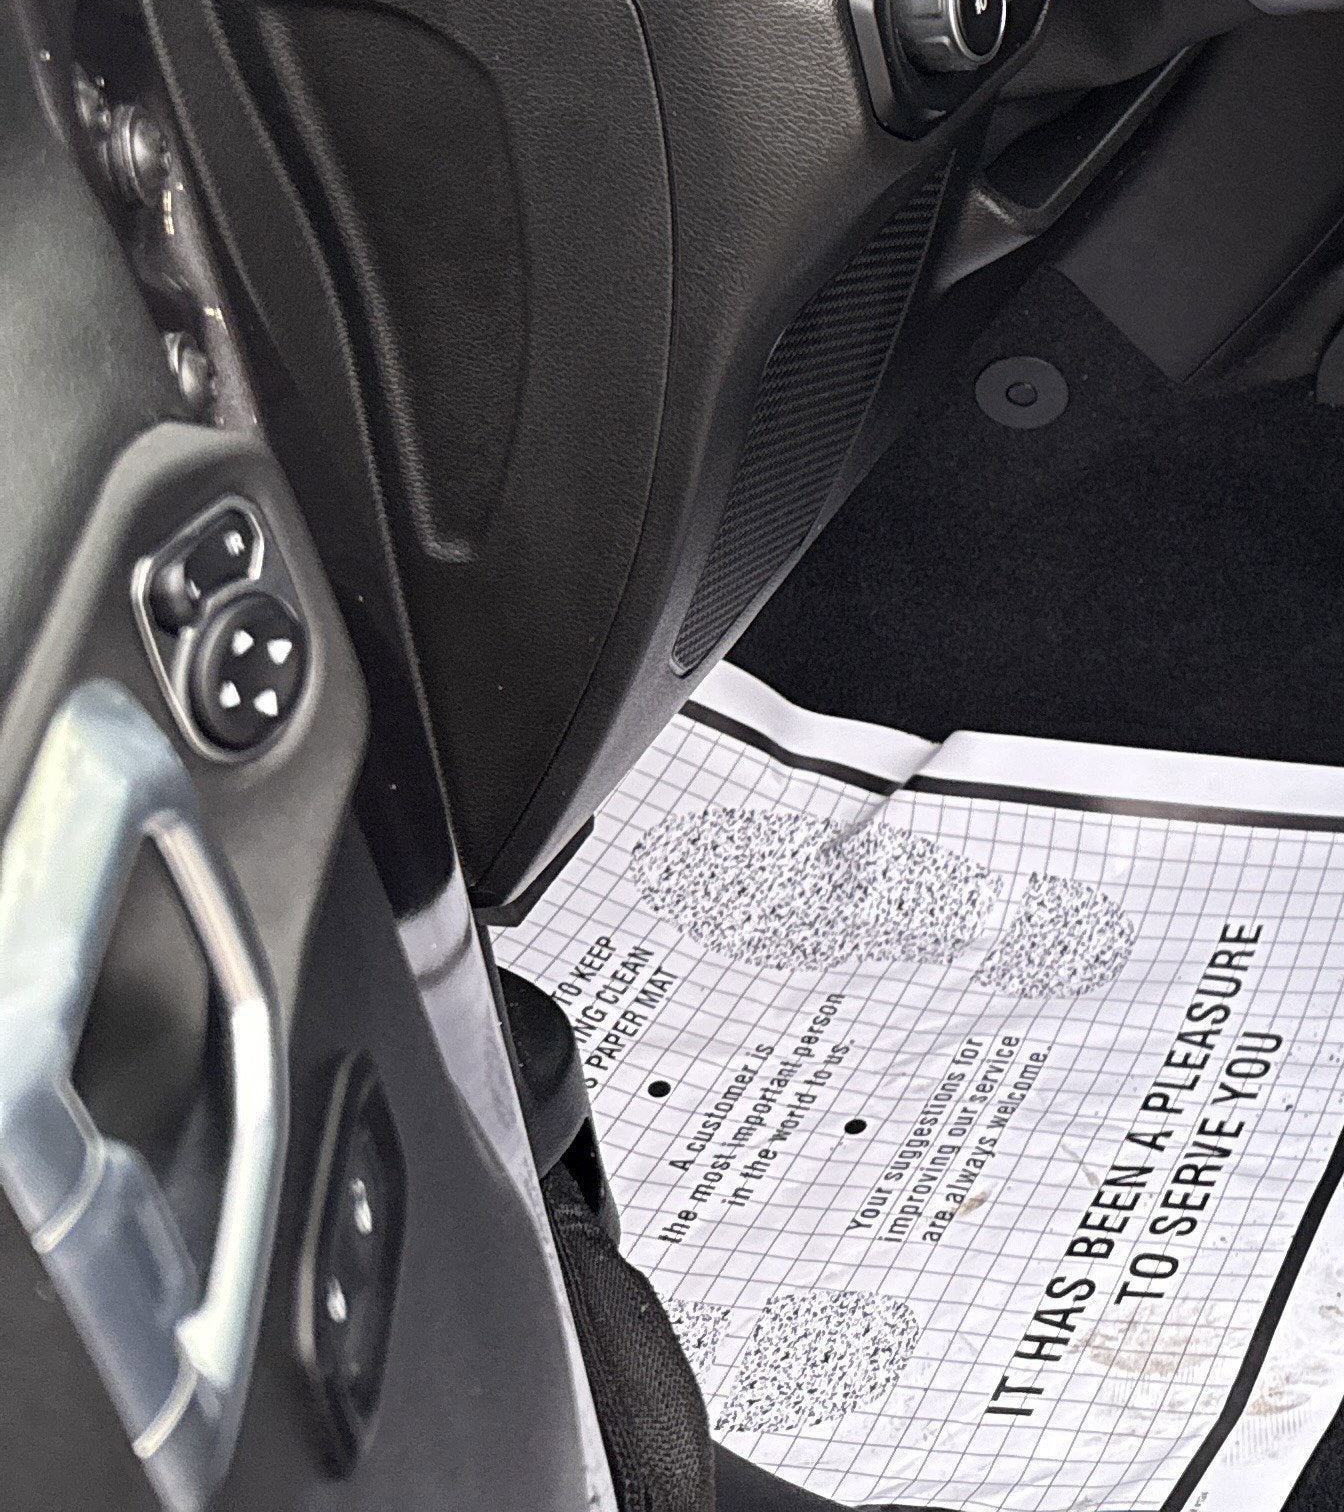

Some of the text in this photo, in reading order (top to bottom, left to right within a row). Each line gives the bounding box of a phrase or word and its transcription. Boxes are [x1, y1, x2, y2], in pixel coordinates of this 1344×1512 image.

[550, 936, 616, 1006] TO KEEP
[584, 965, 679, 1071] PAPER MAT
[596, 945, 654, 1005] CLEAN
[658, 992, 846, 1244] the most important person
[668, 1042, 775, 1172] A customer is
[721, 1039, 855, 1207] in the world to us.
[846, 1037, 984, 1232] Your suggestions for
[878, 1035, 1020, 1242] improving our service
[922, 1045, 1052, 1242] are always welcome.
[986, 922, 1263, 1417] IT HAS BEEN A PLEASURE
[1115, 1031, 1283, 1305] TO SERVE YOU
